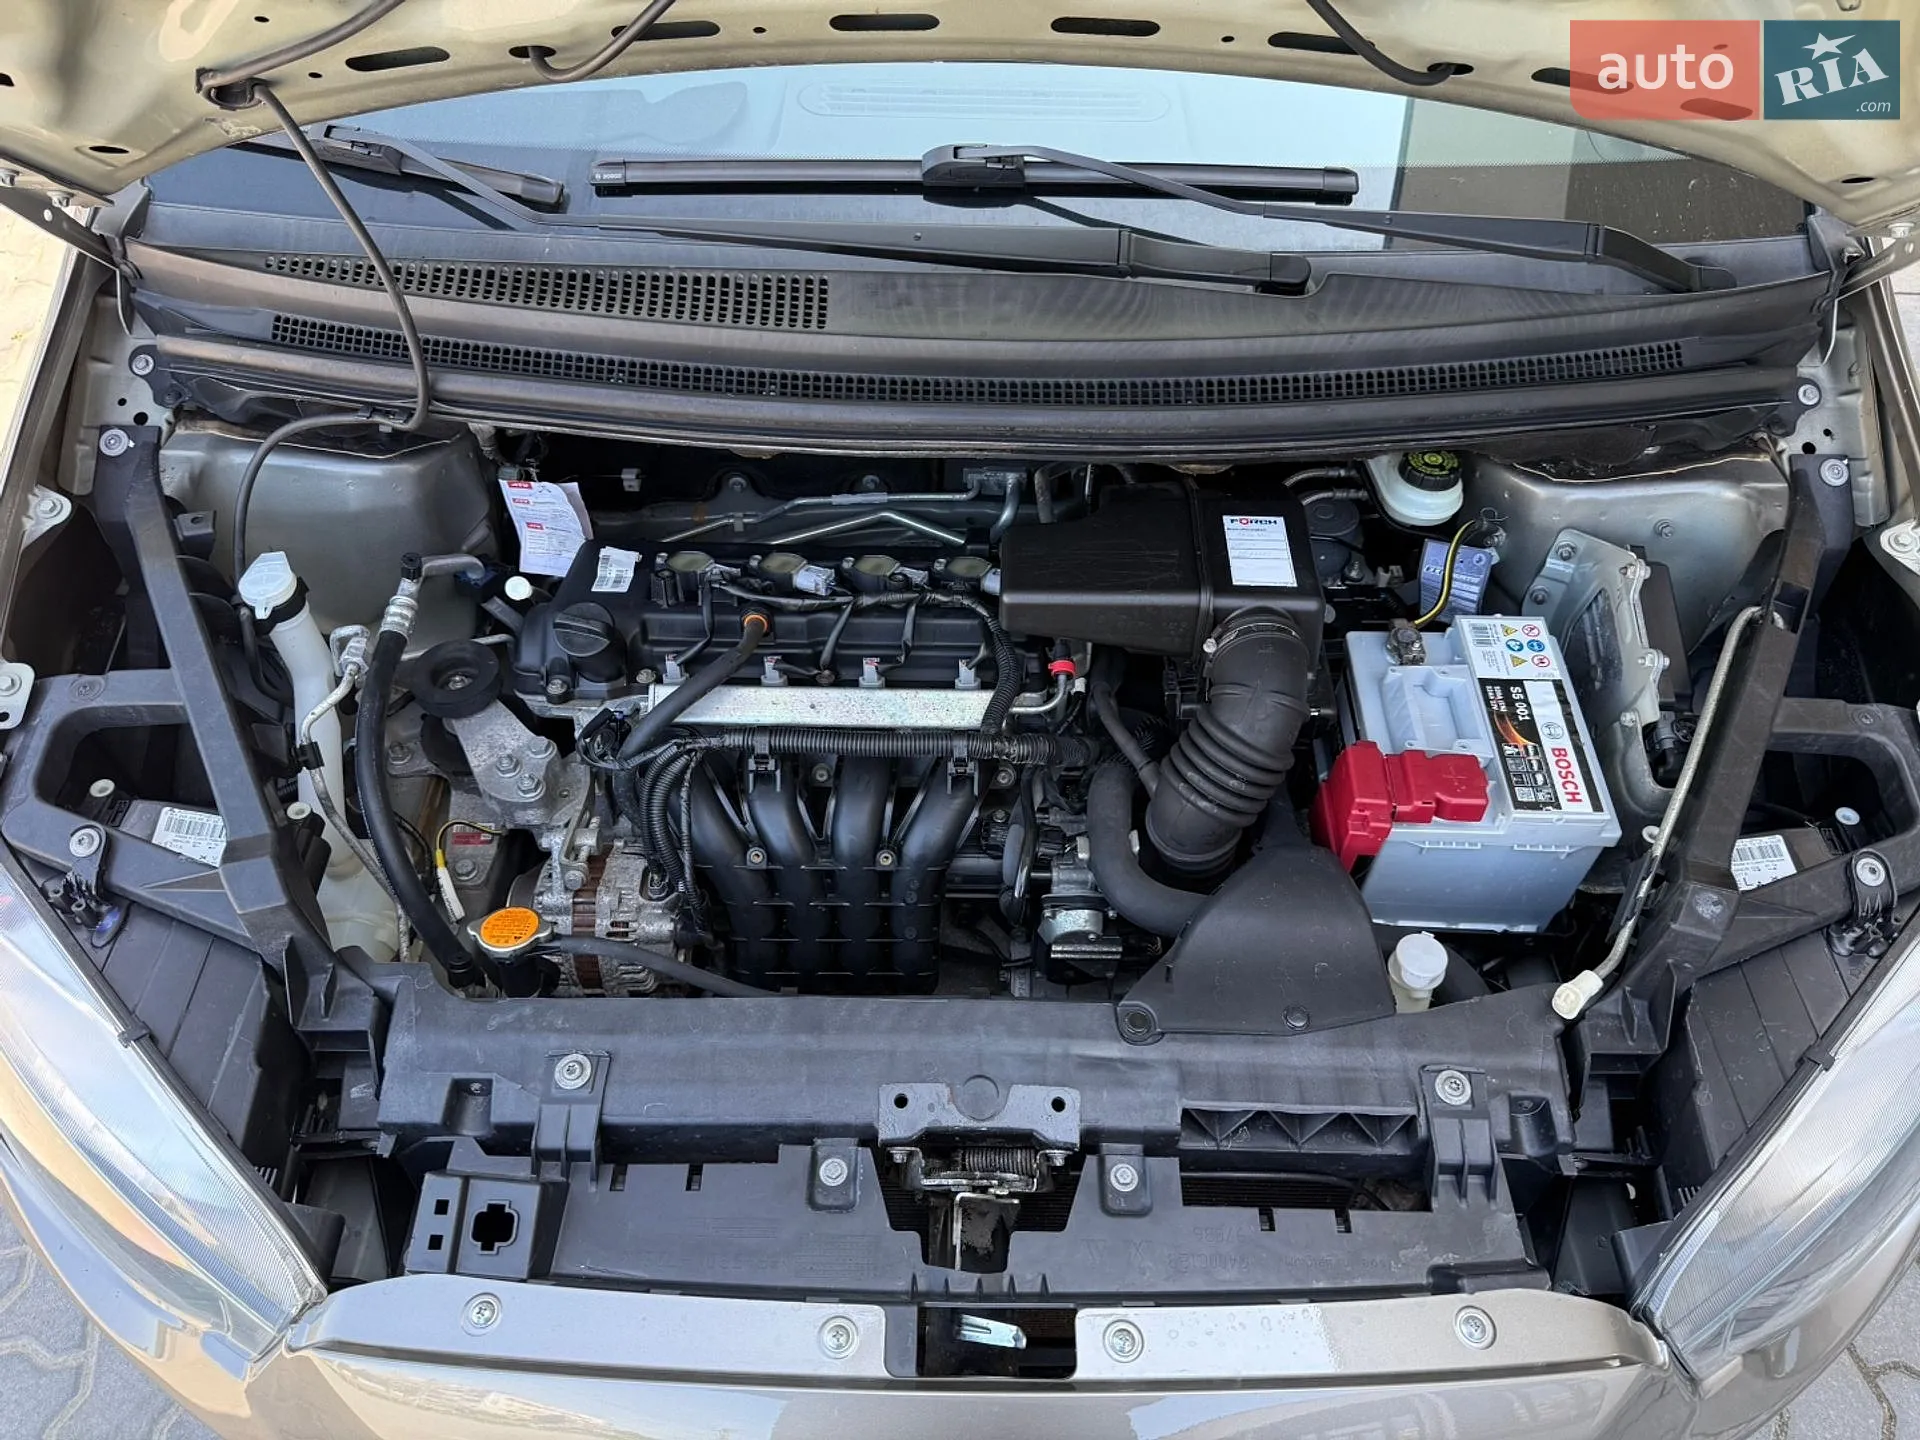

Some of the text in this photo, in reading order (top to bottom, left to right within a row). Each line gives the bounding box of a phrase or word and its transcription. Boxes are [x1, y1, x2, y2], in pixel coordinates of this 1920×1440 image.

[1510, 686, 1531, 721] S5 001
[1551, 747, 1583, 803] BOSCH
